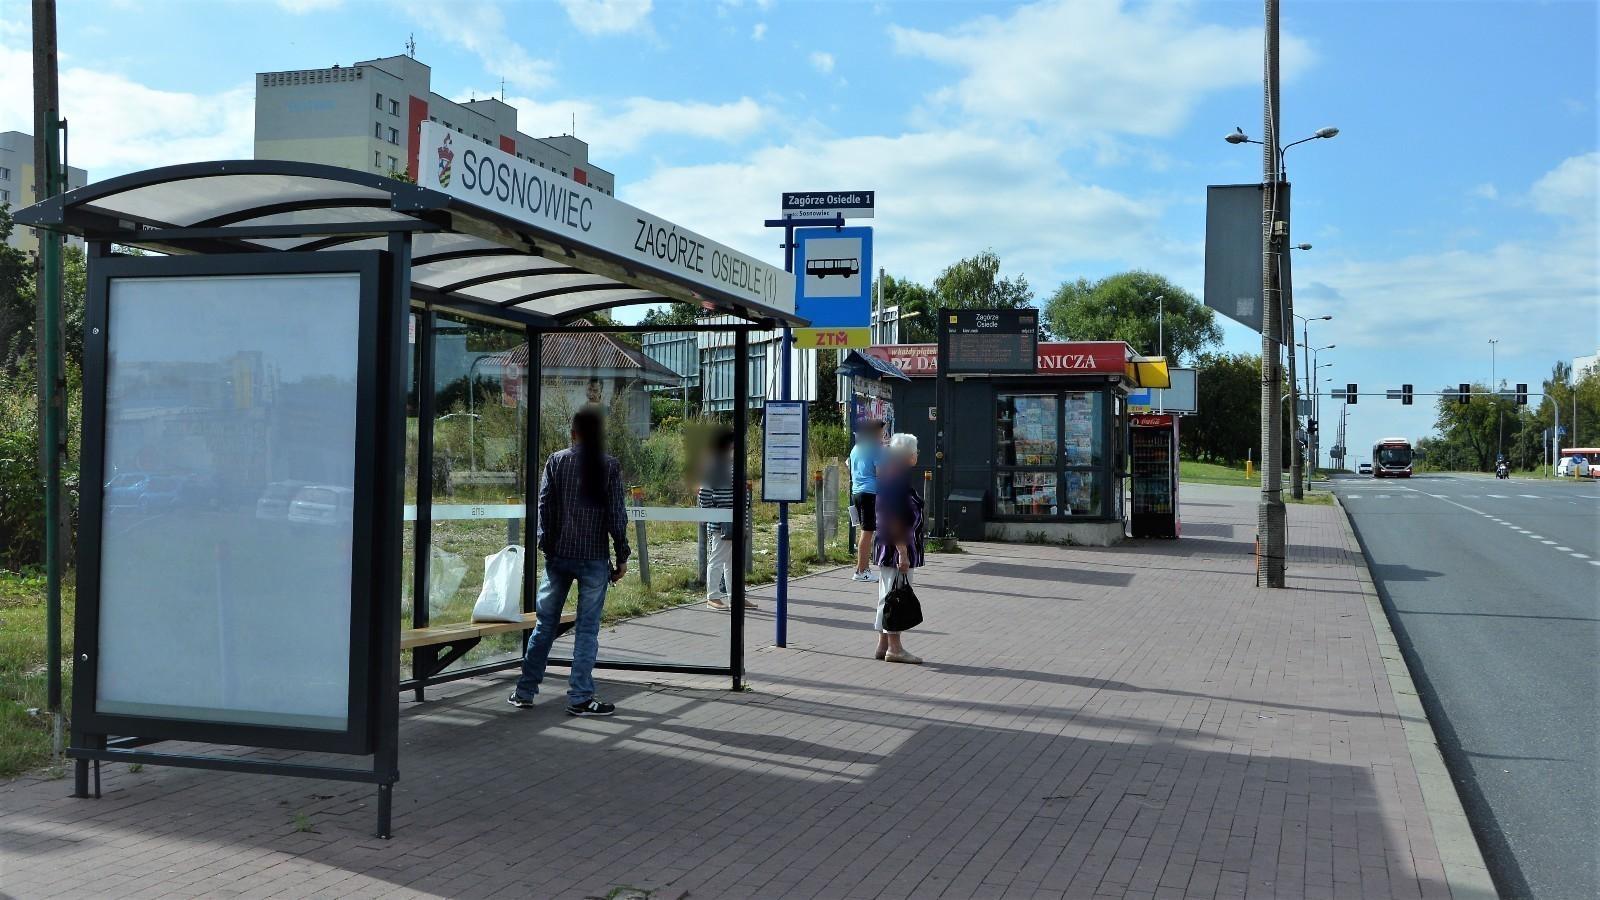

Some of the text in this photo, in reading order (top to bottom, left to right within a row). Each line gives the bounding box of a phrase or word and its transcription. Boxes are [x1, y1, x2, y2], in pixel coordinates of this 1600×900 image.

[461, 149, 593, 232] SOSNOWIEC
[789, 195, 871, 207] Zagórze Osiedle 1
[634, 218, 777, 305] ZAGÓRZE OSIEDLE (1)
[816, 331, 848, 346] ZTM
